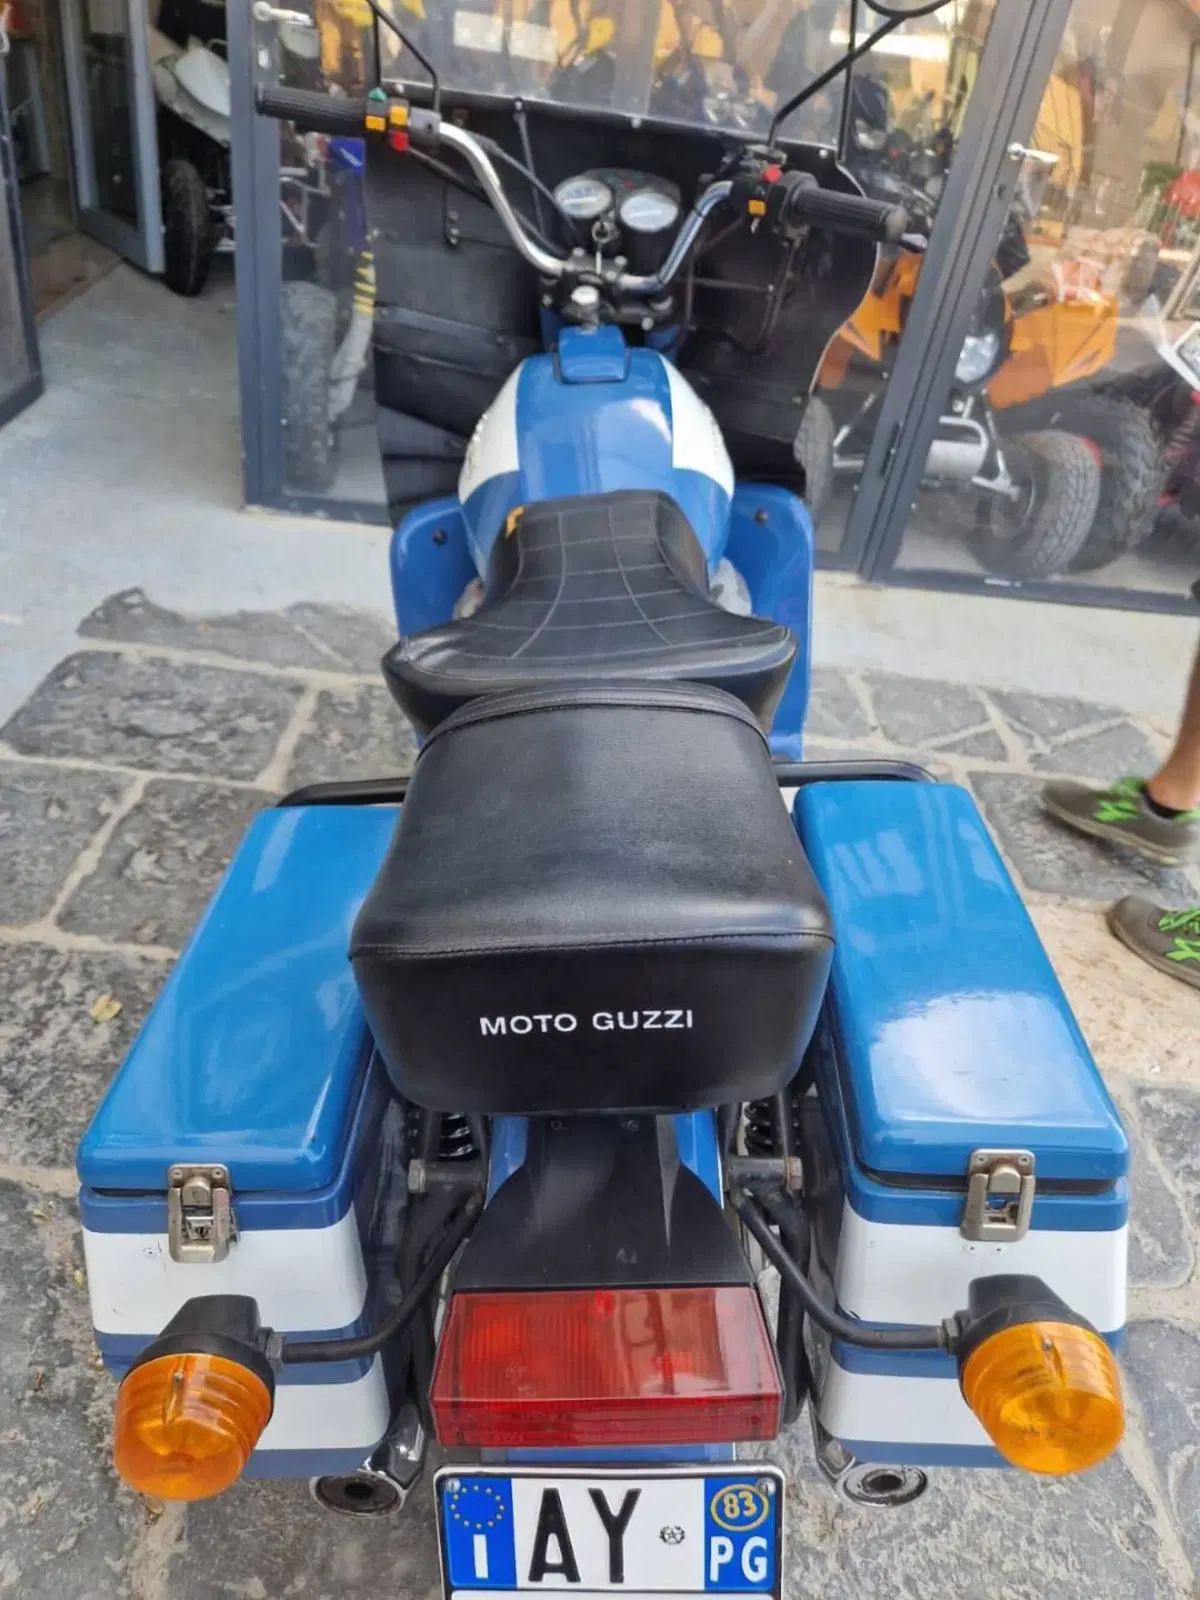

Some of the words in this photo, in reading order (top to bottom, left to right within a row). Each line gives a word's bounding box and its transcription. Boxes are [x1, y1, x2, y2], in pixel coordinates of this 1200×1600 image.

[479, 1013, 577, 1036] MOTO
[592, 1009, 693, 1030] GUZZI
[723, 1492, 757, 1519] 83
[473, 1534, 488, 1579] I
[528, 1487, 642, 1583] AY
[709, 1536, 768, 1583] PG
